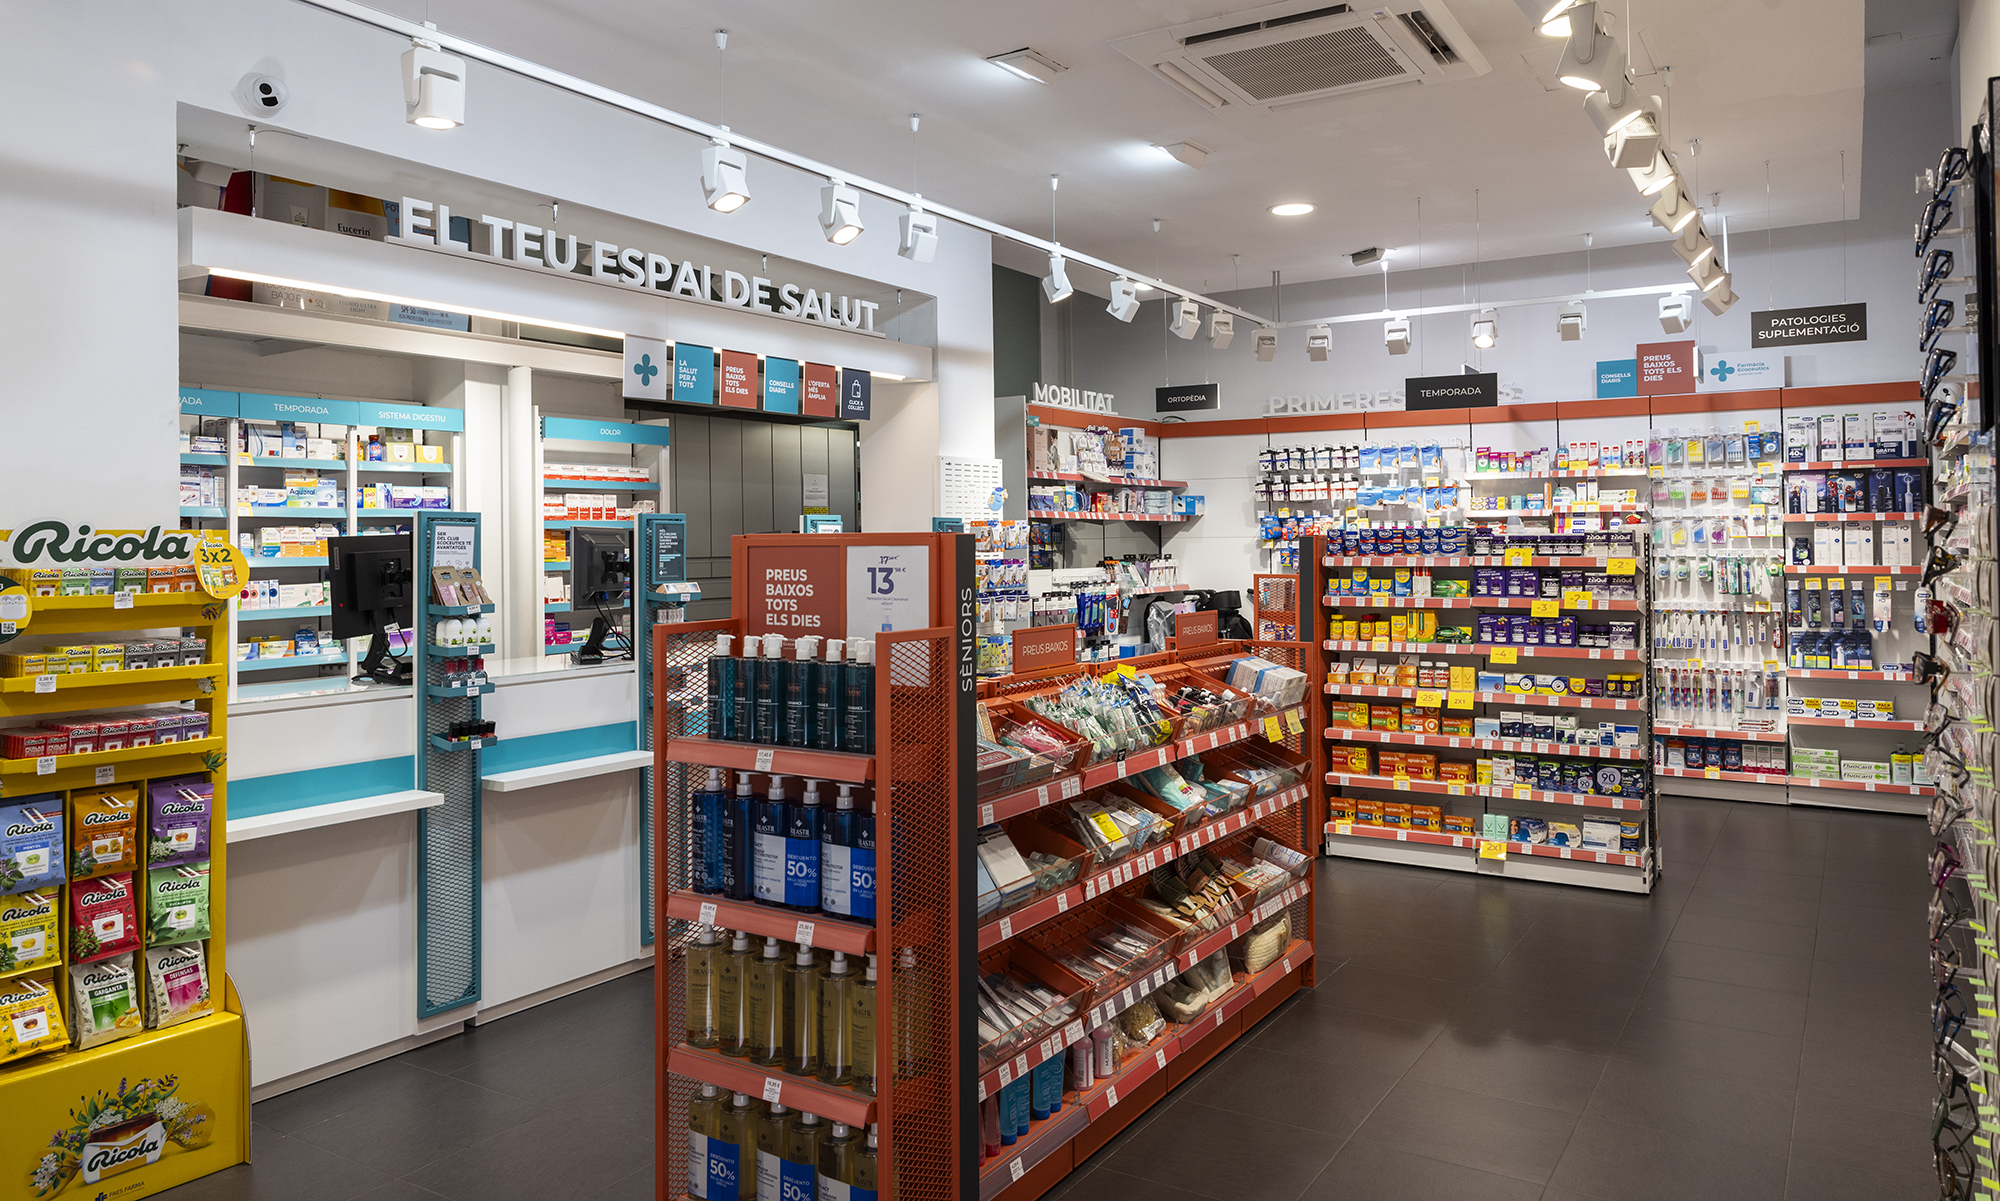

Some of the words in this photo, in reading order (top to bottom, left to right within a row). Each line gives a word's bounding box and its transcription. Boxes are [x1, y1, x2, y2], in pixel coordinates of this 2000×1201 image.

[337, 222, 371, 237] Eucerin
[402, 196, 469, 251] EL
[480, 213, 578, 273] TEU
[591, 239, 713, 300] ESPAI
[721, 269, 771, 312] DE
[779, 283, 879, 332] SALUT
[271, 290, 294, 302] BAJO
[1771, 313, 1846, 328] PATOLOGIES
[1758, 322, 1860, 340] SUPLEMENTACIÓ
[726, 366, 744, 374] PREUS
[1643, 360, 1676, 368] BAIXOS
[679, 366, 698, 375] SALUT
[1601, 372, 1632, 380] CONSELLS
[1643, 367, 1665, 375] TOTS
[726, 372, 746, 382] BAIXOS
[769, 380, 795, 389] CONSELLS
[769, 386, 786, 394] DIARIS
[808, 380, 830, 389] L'OFERTA
[736, 387, 749, 395] DIES
[1033, 382, 1114, 412] MOBILITAT
[1420, 387, 1481, 398] TEMPORADA
[1167, 393, 1206, 403] ORTOPÈDIA
[1268, 388, 1405, 415] PRIMERES
[274, 403, 329, 415] TEMPORADA
[378, 411, 411, 422] SISTEMA
[412, 413, 446, 424] DIGESTIU
[600, 428, 621, 436] DOLOR
[12, 520, 191, 564] Ricola
[200, 548, 232, 563] 3x2
[766, 569, 807, 581] PREUS
[766, 584, 814, 596] BAIXOS
[766, 599, 798, 611] TOTS
[766, 613, 788, 626] ELS
[791, 614, 821, 627] DIES
[1183, 626, 1197, 635] PREUS
[1198, 623, 1213, 633] BAIXOS
[961, 587, 972, 692] SÈNIORS
[1023, 644, 1044, 656] PREUS
[1045, 641, 1068, 653] BAIXOS
[101, 726, 128, 735] Ricola
[1602, 773, 1616, 783] 90
[160, 802, 204, 814] Ricola
[84, 811, 130, 825] Ricola
[6, 822, 53, 837] Ricola
[1487, 843, 1502, 851] 2x1
[787, 861, 817, 878] 50%
[159, 880, 200, 893] Ricola
[82, 889, 126, 905] Ricola
[2, 906, 50, 921] Ricola
[169, 967, 193, 979] DEFENSAS
[94, 984, 124, 996] GARGANTA
[87, 1138, 159, 1172] Ricola
[710, 1153, 735, 1164] DESCUENTO
[710, 1160, 735, 1180] 50%
[783, 1175, 810, 1185] DESCUENTO
[109, 1188, 124, 1198] FAES
[124, 1181, 145, 1191] FARMA
